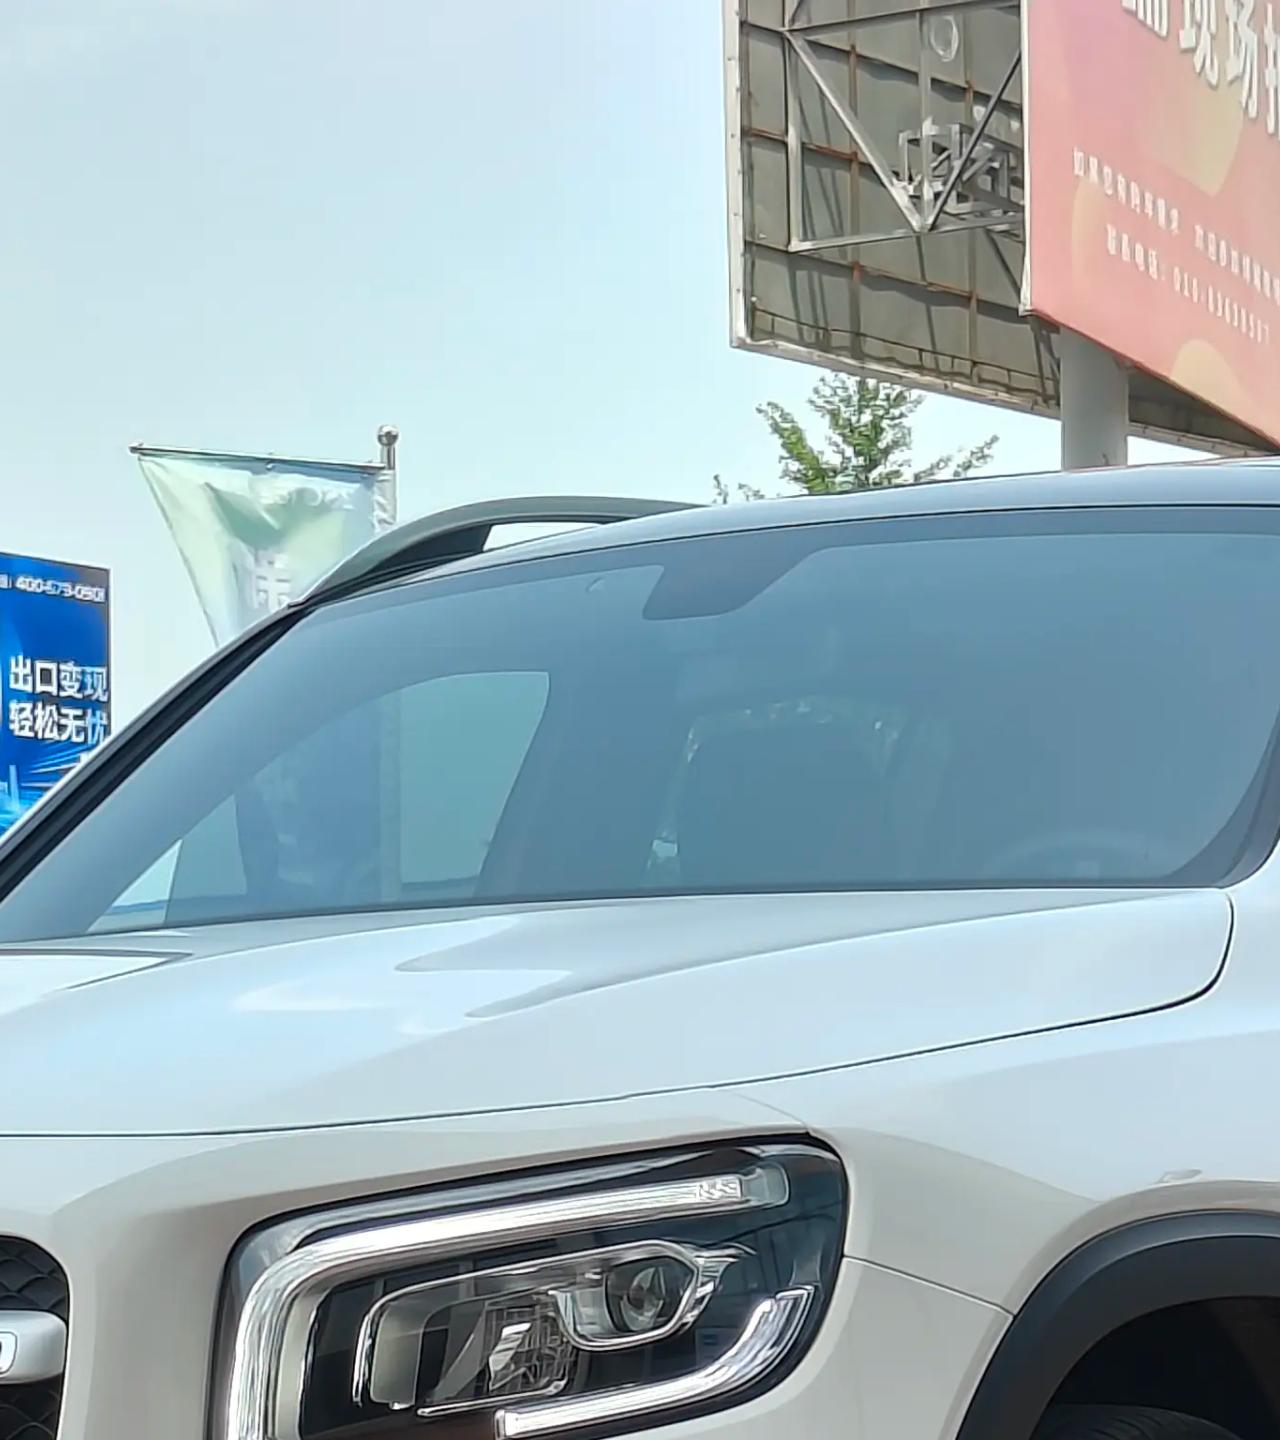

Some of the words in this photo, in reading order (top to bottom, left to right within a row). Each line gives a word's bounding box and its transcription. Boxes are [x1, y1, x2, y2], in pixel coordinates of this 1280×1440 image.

[9, 652, 108, 702] 出口变现
[9, 700, 109, 744] 轻松无忧
